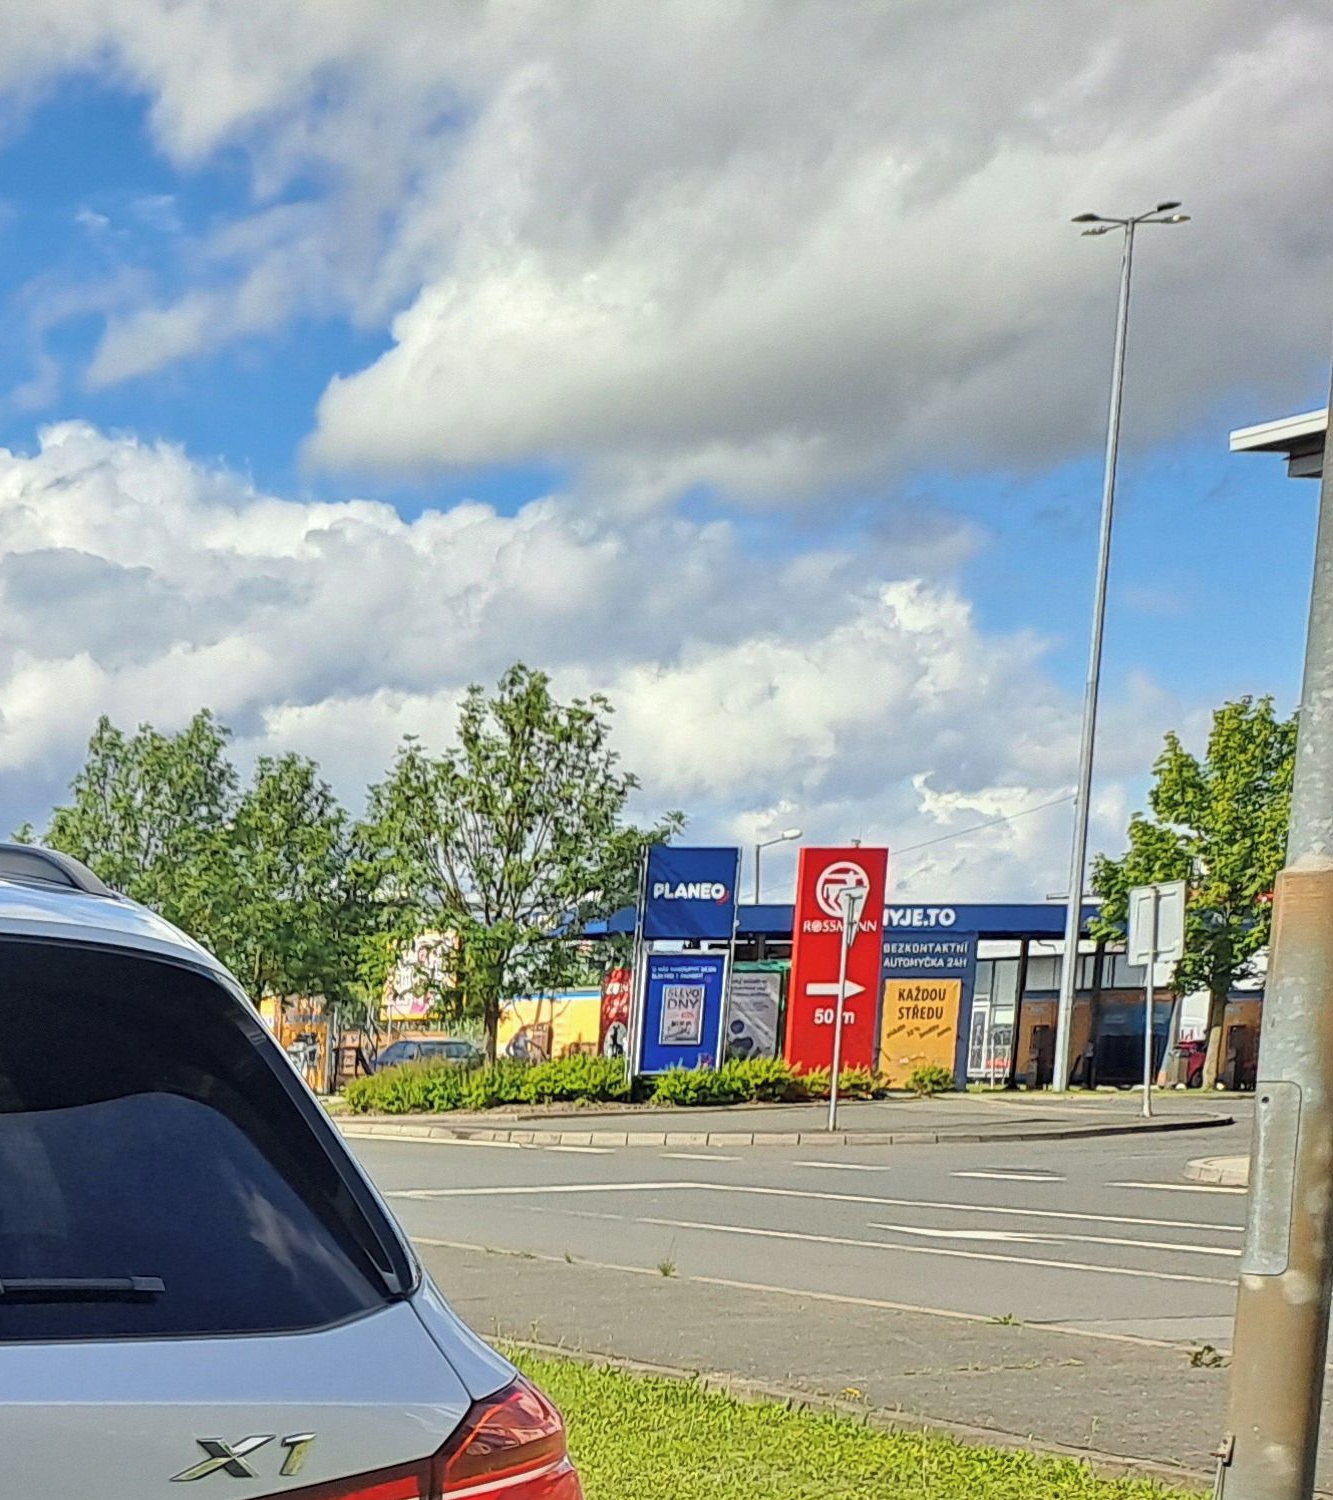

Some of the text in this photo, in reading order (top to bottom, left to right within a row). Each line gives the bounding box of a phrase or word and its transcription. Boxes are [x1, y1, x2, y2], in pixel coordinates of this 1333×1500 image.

[653, 882, 725, 900] PLANEO
[803, 919, 878, 933] ROSSMNN
[883, 940, 969, 954] BEZKONTAKTNÍ
[883, 956, 968, 968] AUTOMYČKA 24H
[897, 985, 947, 1001] KAŽDOU
[666, 999, 699, 1009] DNY
[897, 1004, 944, 1020] STŘEDU
[169, 1432, 317, 1483] X1
